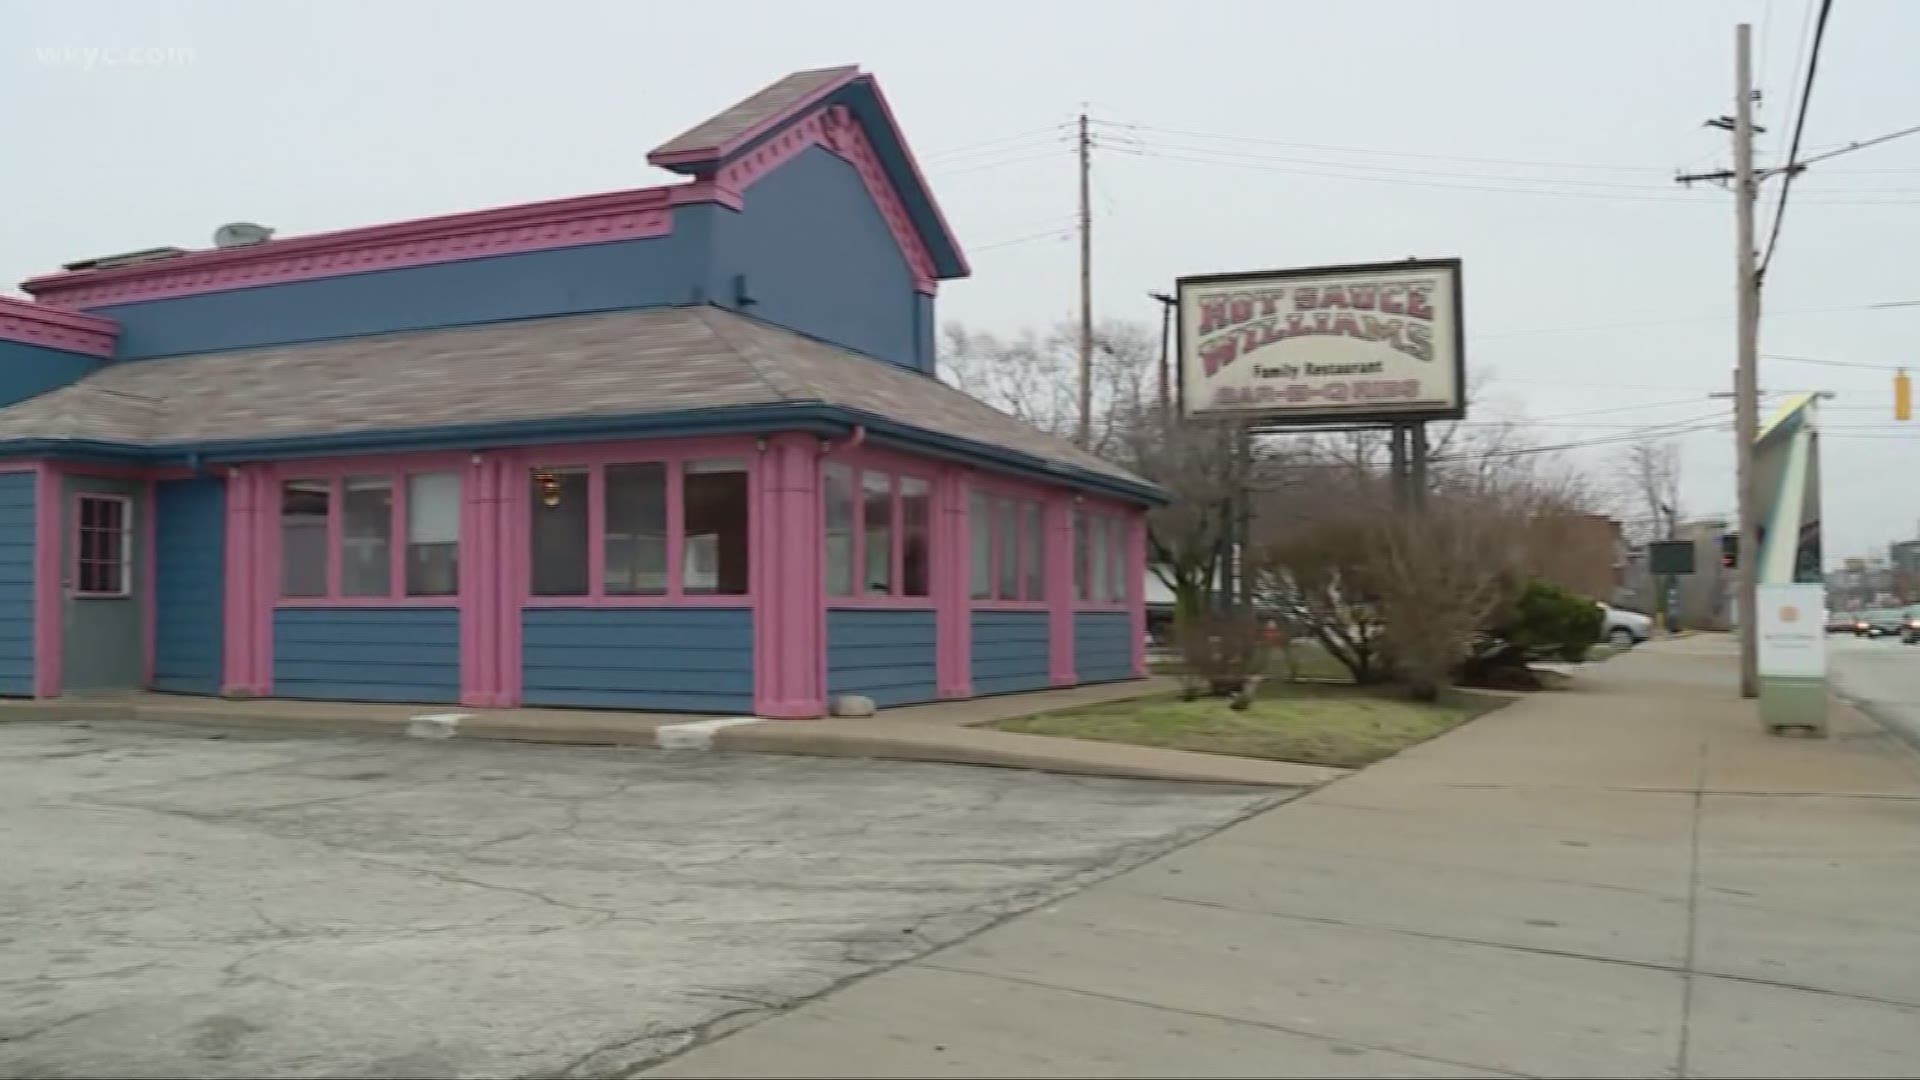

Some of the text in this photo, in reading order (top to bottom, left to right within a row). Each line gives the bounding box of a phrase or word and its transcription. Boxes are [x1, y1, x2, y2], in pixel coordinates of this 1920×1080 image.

[1198, 280, 1435, 336] HOT SAUCE
[1198, 311, 1435, 378] WILLIAMS
[1253, 361, 1384, 379] Family Restaurant
